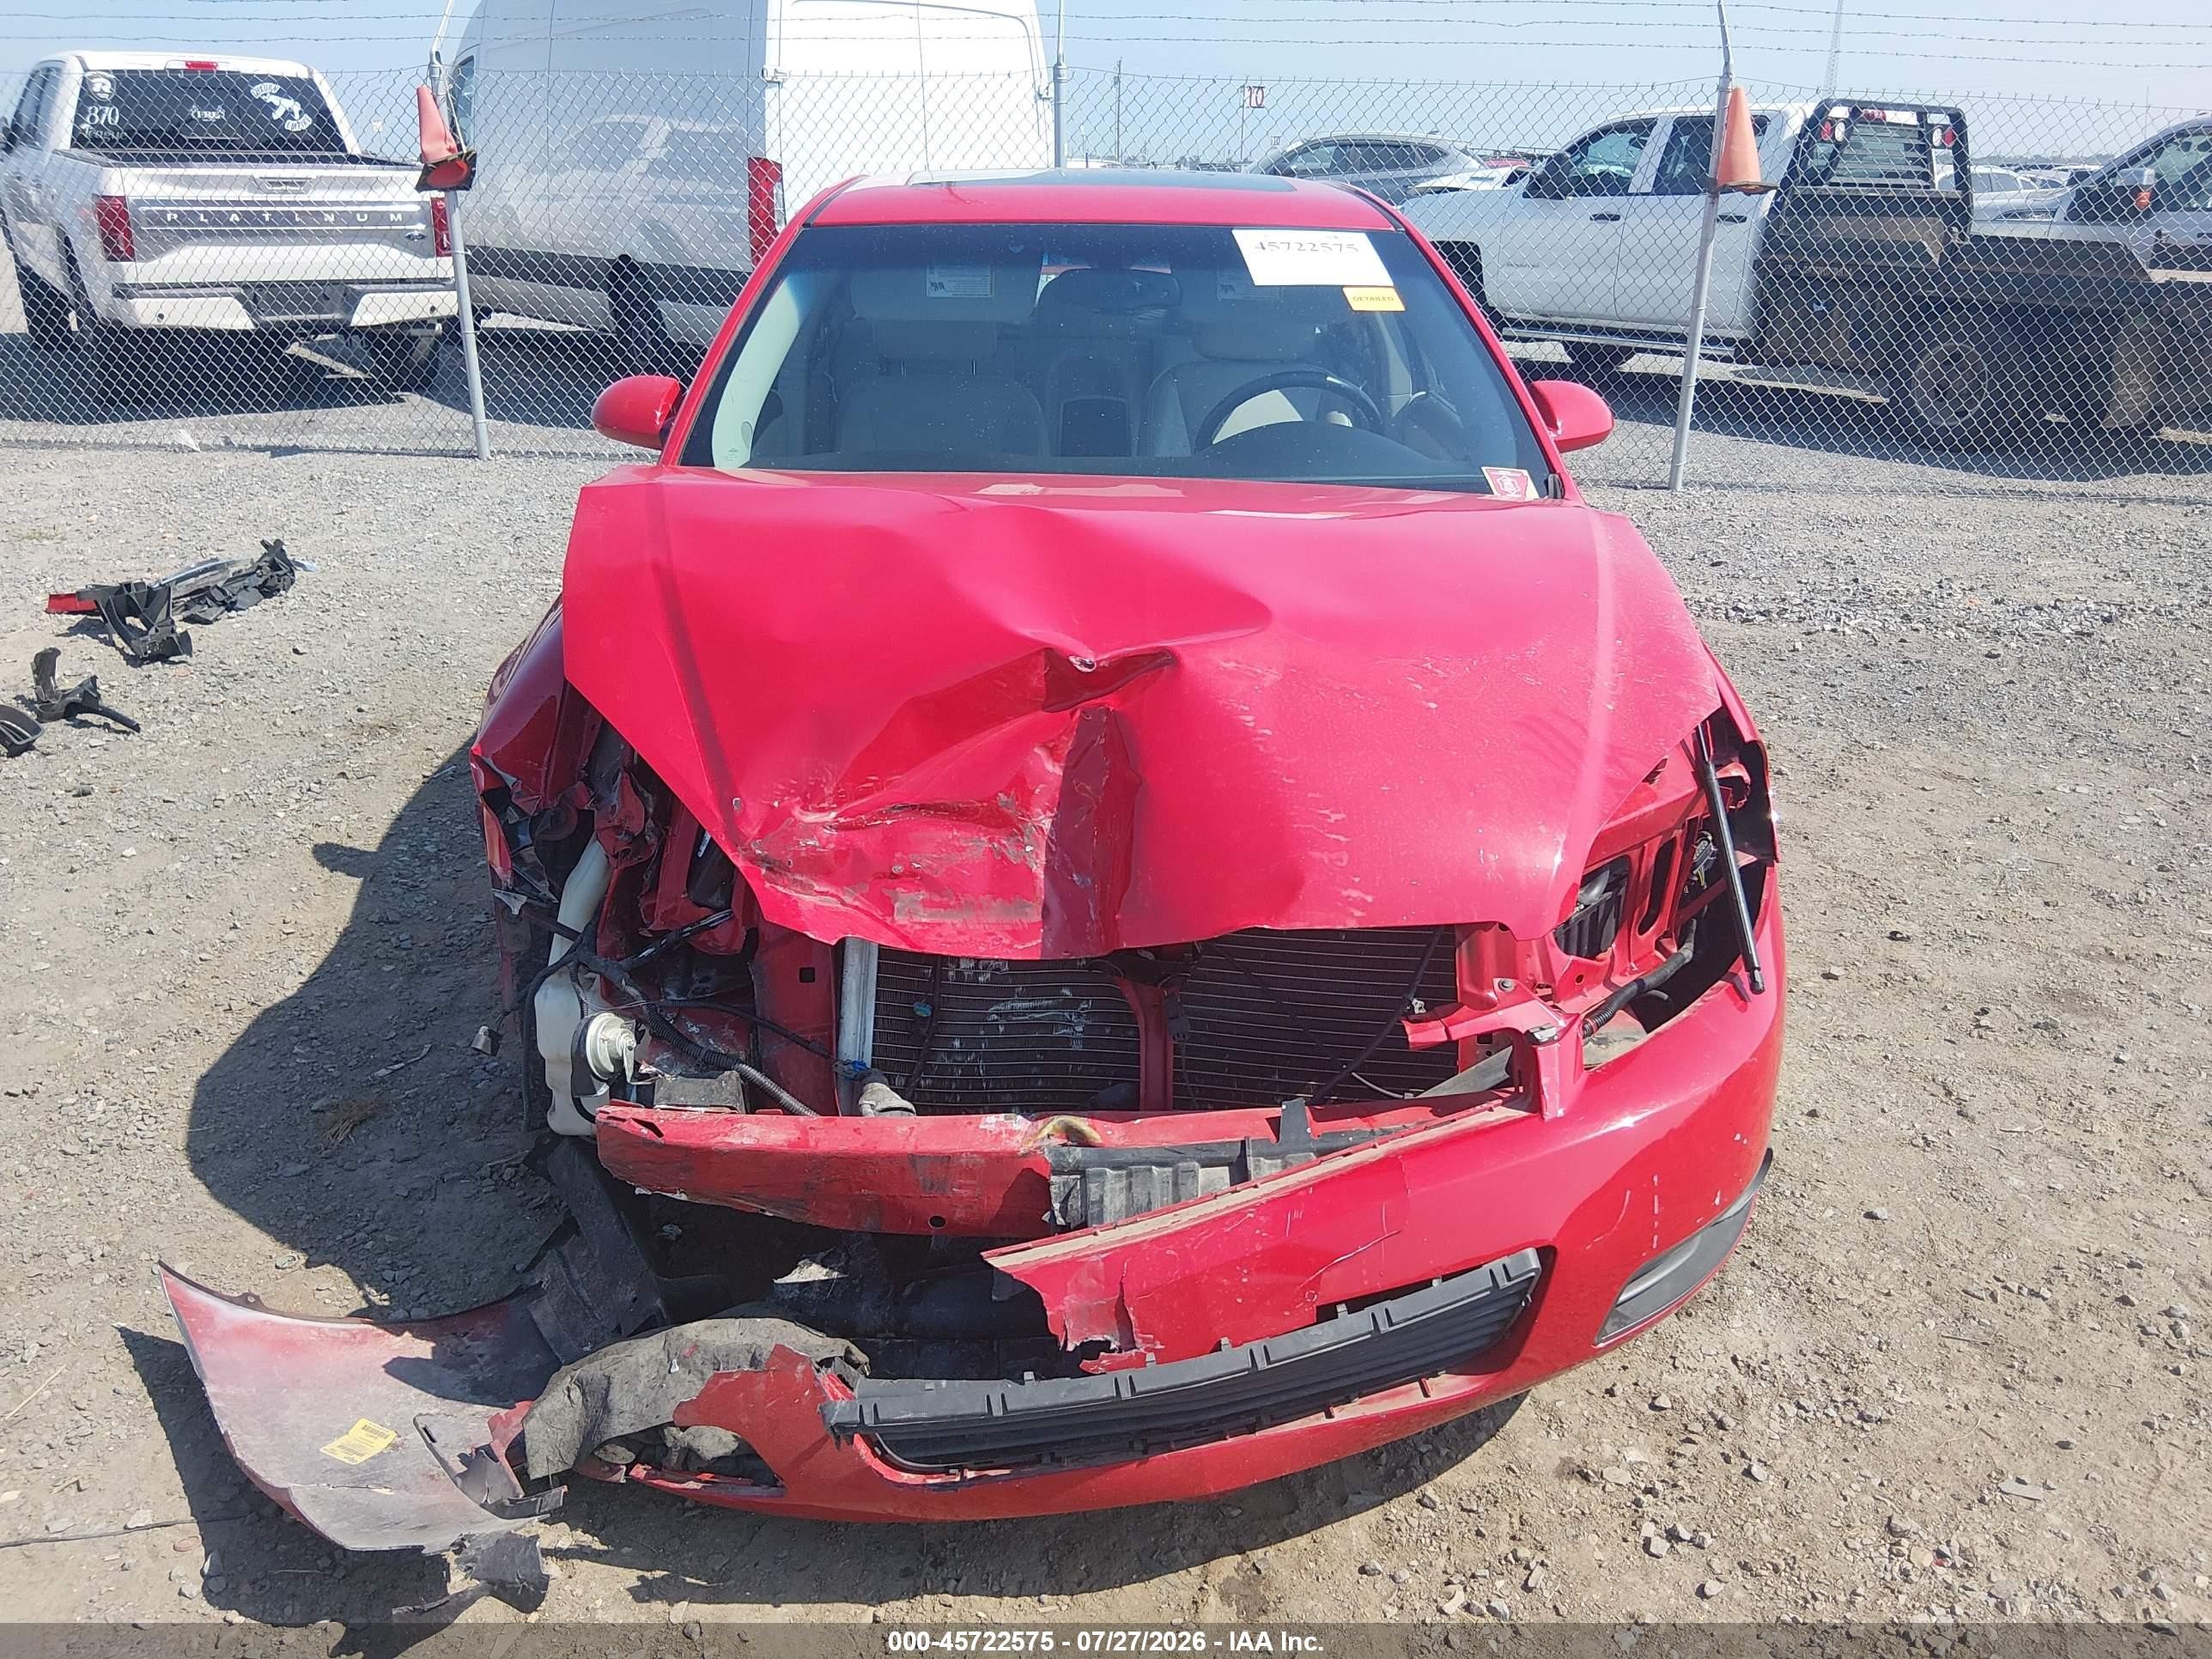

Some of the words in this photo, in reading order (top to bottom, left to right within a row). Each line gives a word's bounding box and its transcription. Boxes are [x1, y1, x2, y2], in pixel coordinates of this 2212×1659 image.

[87, 106, 119, 125] 870
[167, 213, 403, 222] PLATINUM
[1255, 241, 1359, 252] 45722575
